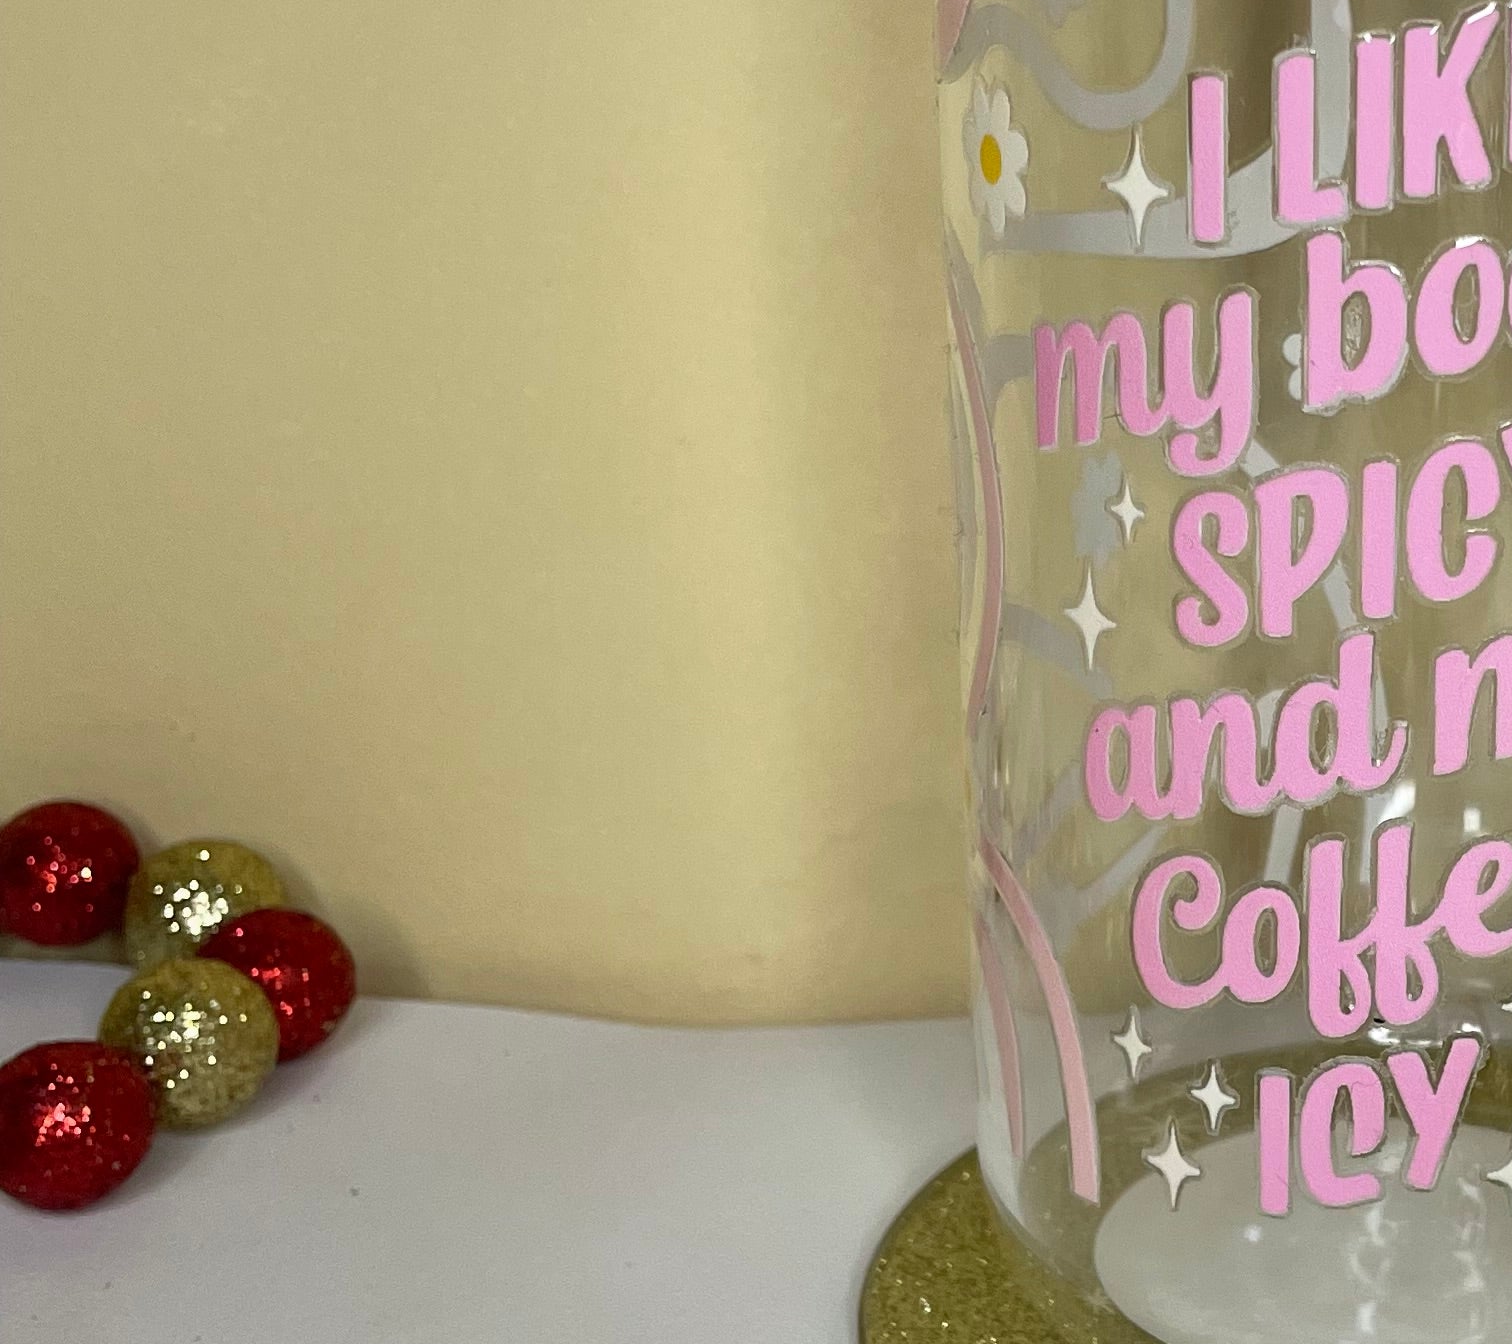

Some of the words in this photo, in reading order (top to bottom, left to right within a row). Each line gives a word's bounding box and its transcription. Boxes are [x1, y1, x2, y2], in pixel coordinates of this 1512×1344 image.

[1190, 74, 1226, 243] I
[1034, 291, 1254, 477] my
[1085, 632, 1406, 821] and
[1257, 1037, 1480, 1215] ICY
